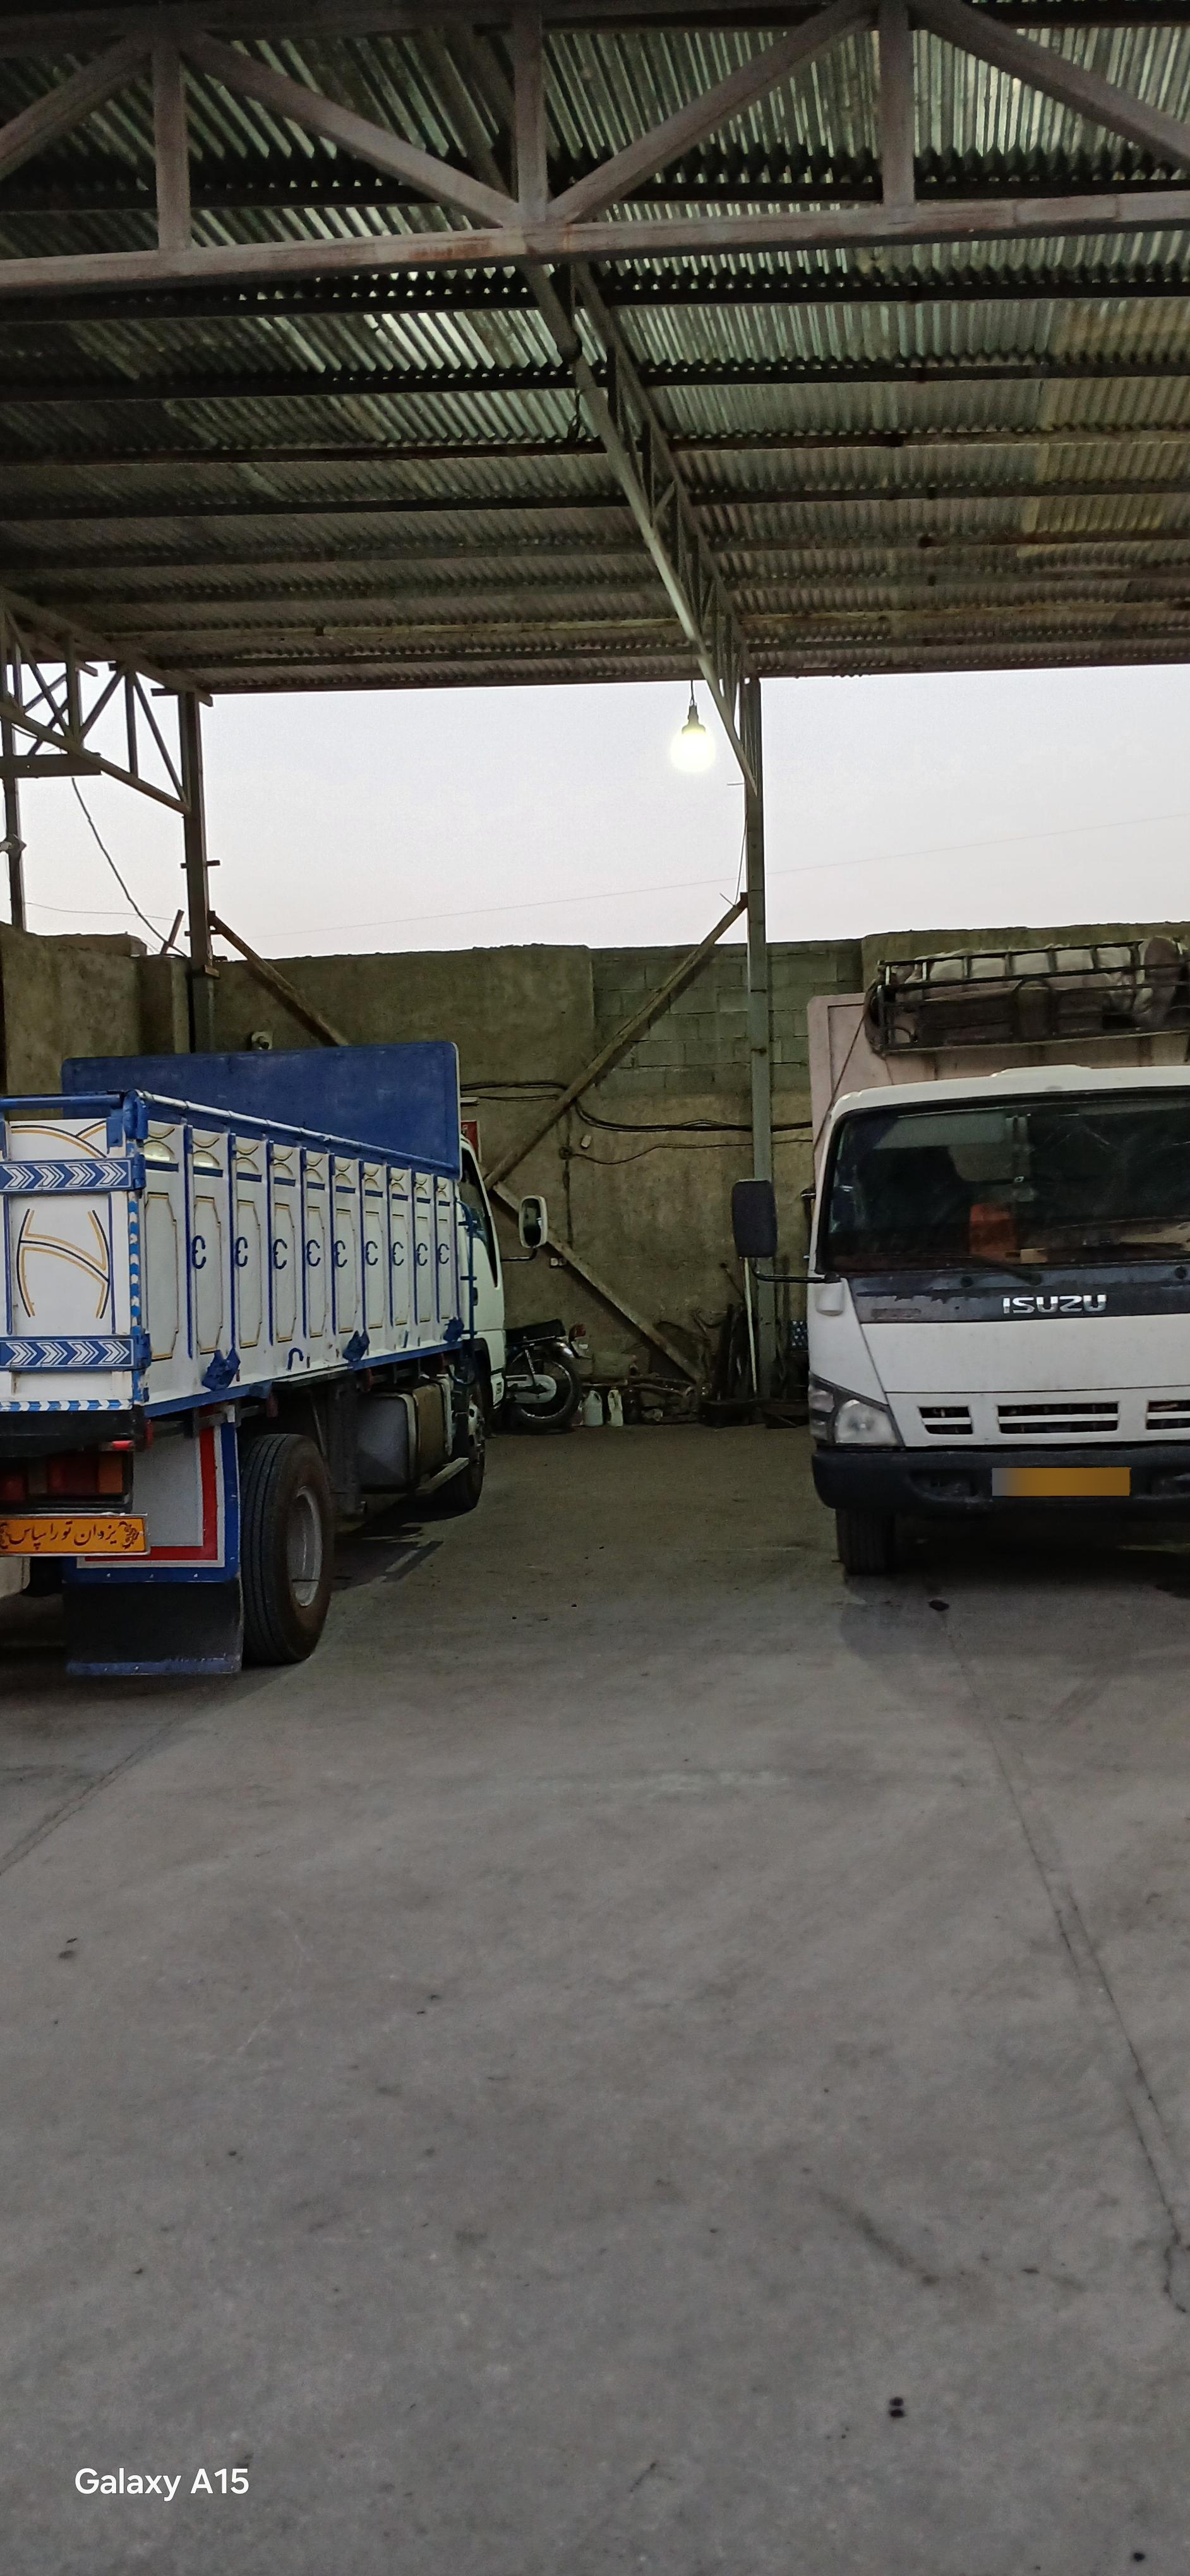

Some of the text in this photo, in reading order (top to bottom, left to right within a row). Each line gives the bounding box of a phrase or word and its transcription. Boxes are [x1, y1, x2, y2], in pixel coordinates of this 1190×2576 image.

[1003, 1294, 1107, 1314] ISUZU
[7, 1526, 46, 1551] سپاس
[73, 1524, 117, 1546] یزدان
